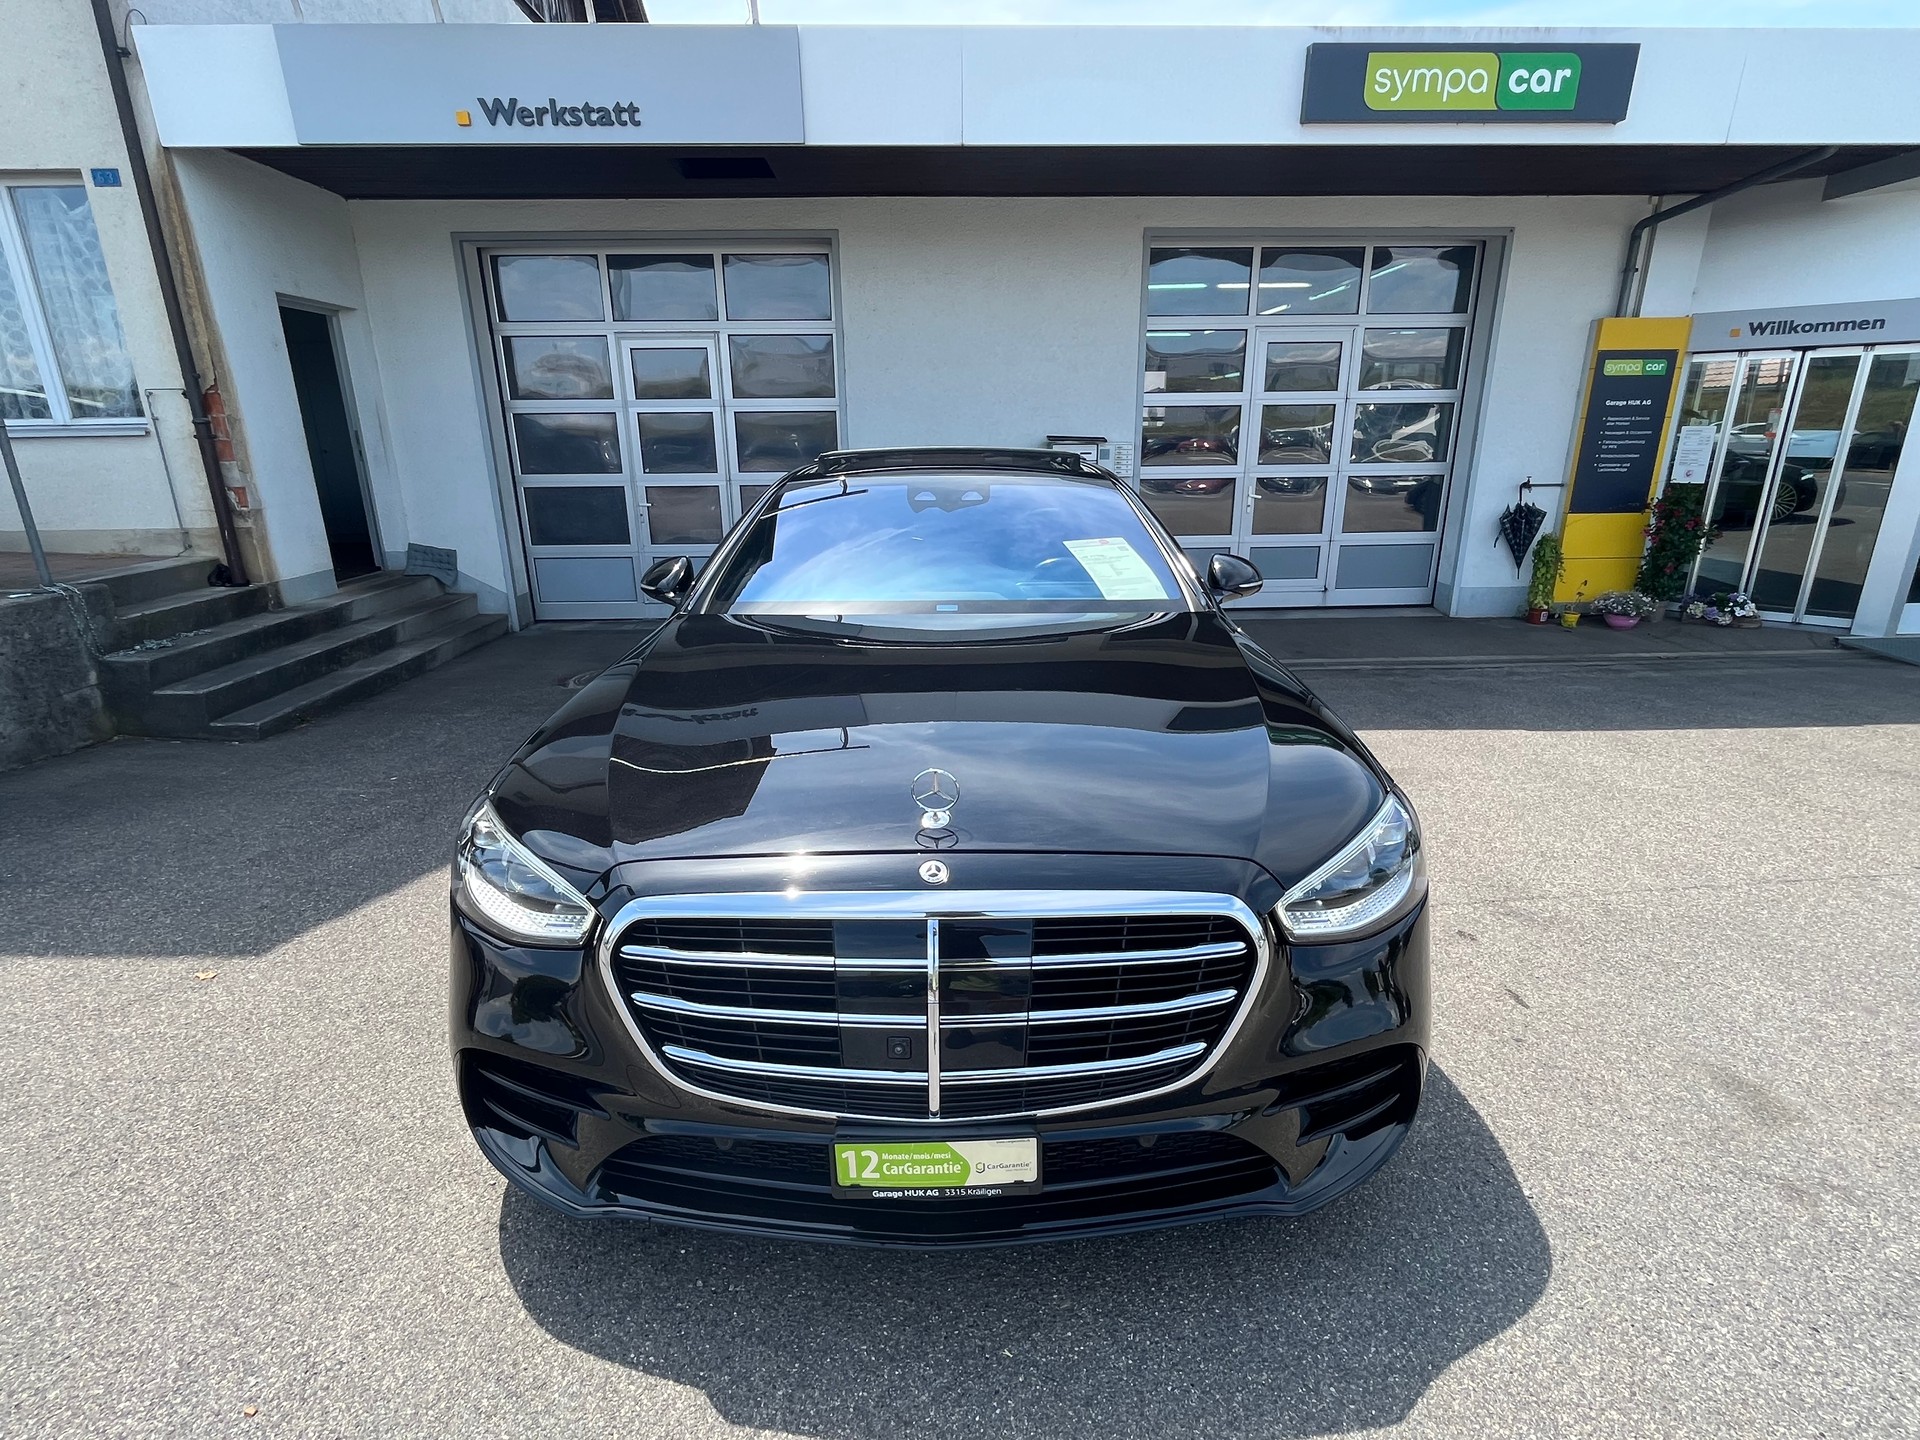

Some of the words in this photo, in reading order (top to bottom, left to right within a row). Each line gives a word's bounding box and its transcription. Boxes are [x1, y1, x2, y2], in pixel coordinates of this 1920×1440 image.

[1374, 68, 1488, 102] sympa
[1508, 68, 1571, 93] car
[477, 97, 641, 126] Werkstatt
[1748, 318, 1886, 336] Willkommen
[1606, 363, 1640, 373] sympa
[1645, 363, 1665, 371] car
[841, 1150, 880, 1178] 12
[872, 1190, 903, 1198] Garage
[945, 1188, 966, 1196] 3315
